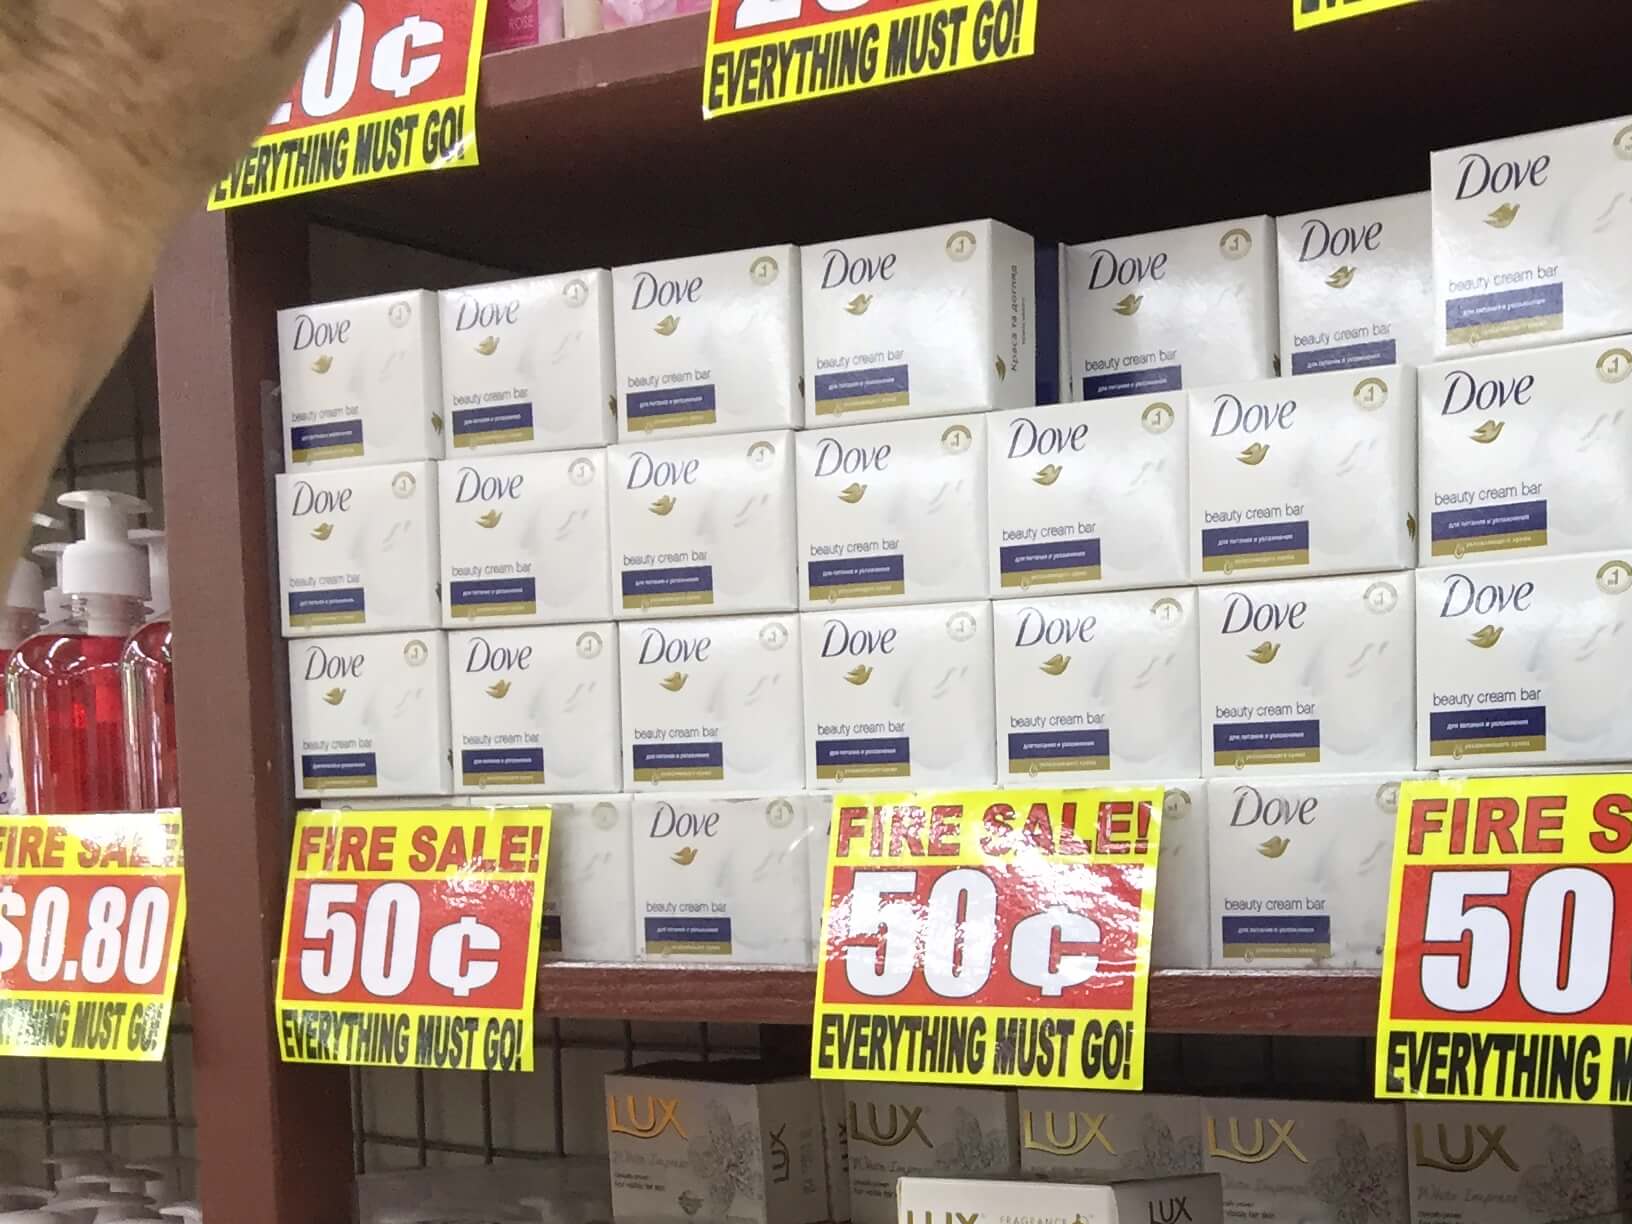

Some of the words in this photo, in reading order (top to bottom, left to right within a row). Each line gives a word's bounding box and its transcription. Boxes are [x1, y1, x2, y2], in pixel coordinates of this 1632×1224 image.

[709, 36, 881, 112] EVERYTHING
[885, 14, 967, 75] MUST
[972, 1, 1022, 60] GO!
[352, 113, 419, 177] MUST
[421, 104, 466, 164] GO!
[1297, 218, 1385, 263] Dove
[820, 245, 898, 291] Dove
[293, 313, 352, 351] Dove
[1220, 592, 1307, 634] Dove
[305, 645, 365, 681] Dove
[649, 800, 721, 839] Dove
[836, 804, 964, 857] FIRE
[979, 800, 1153, 857] SALE!
[1407, 795, 1568, 855] FIRE
[0, 826, 66, 869] IRE
[296, 827, 395, 872] FIRE
[409, 826, 542, 872] SALE!
[72, 1000, 128, 1050] MUST
[281, 1012, 410, 1065] EVERYTHING
[415, 1018, 477, 1068] MUST
[483, 1019, 524, 1073] GO!
[818, 1013, 987, 1075] EVERYTHING
[993, 1017, 1075, 1077] MUST
[1081, 1020, 1133, 1080] GO!
[1385, 1030, 1601, 1101] EVERYTHING
[607, 1094, 689, 1142] LUX
[849, 1102, 934, 1149] LUX
[1207, 1117, 1308, 1164] LUX
[1413, 1122, 1520, 1174] LUX
